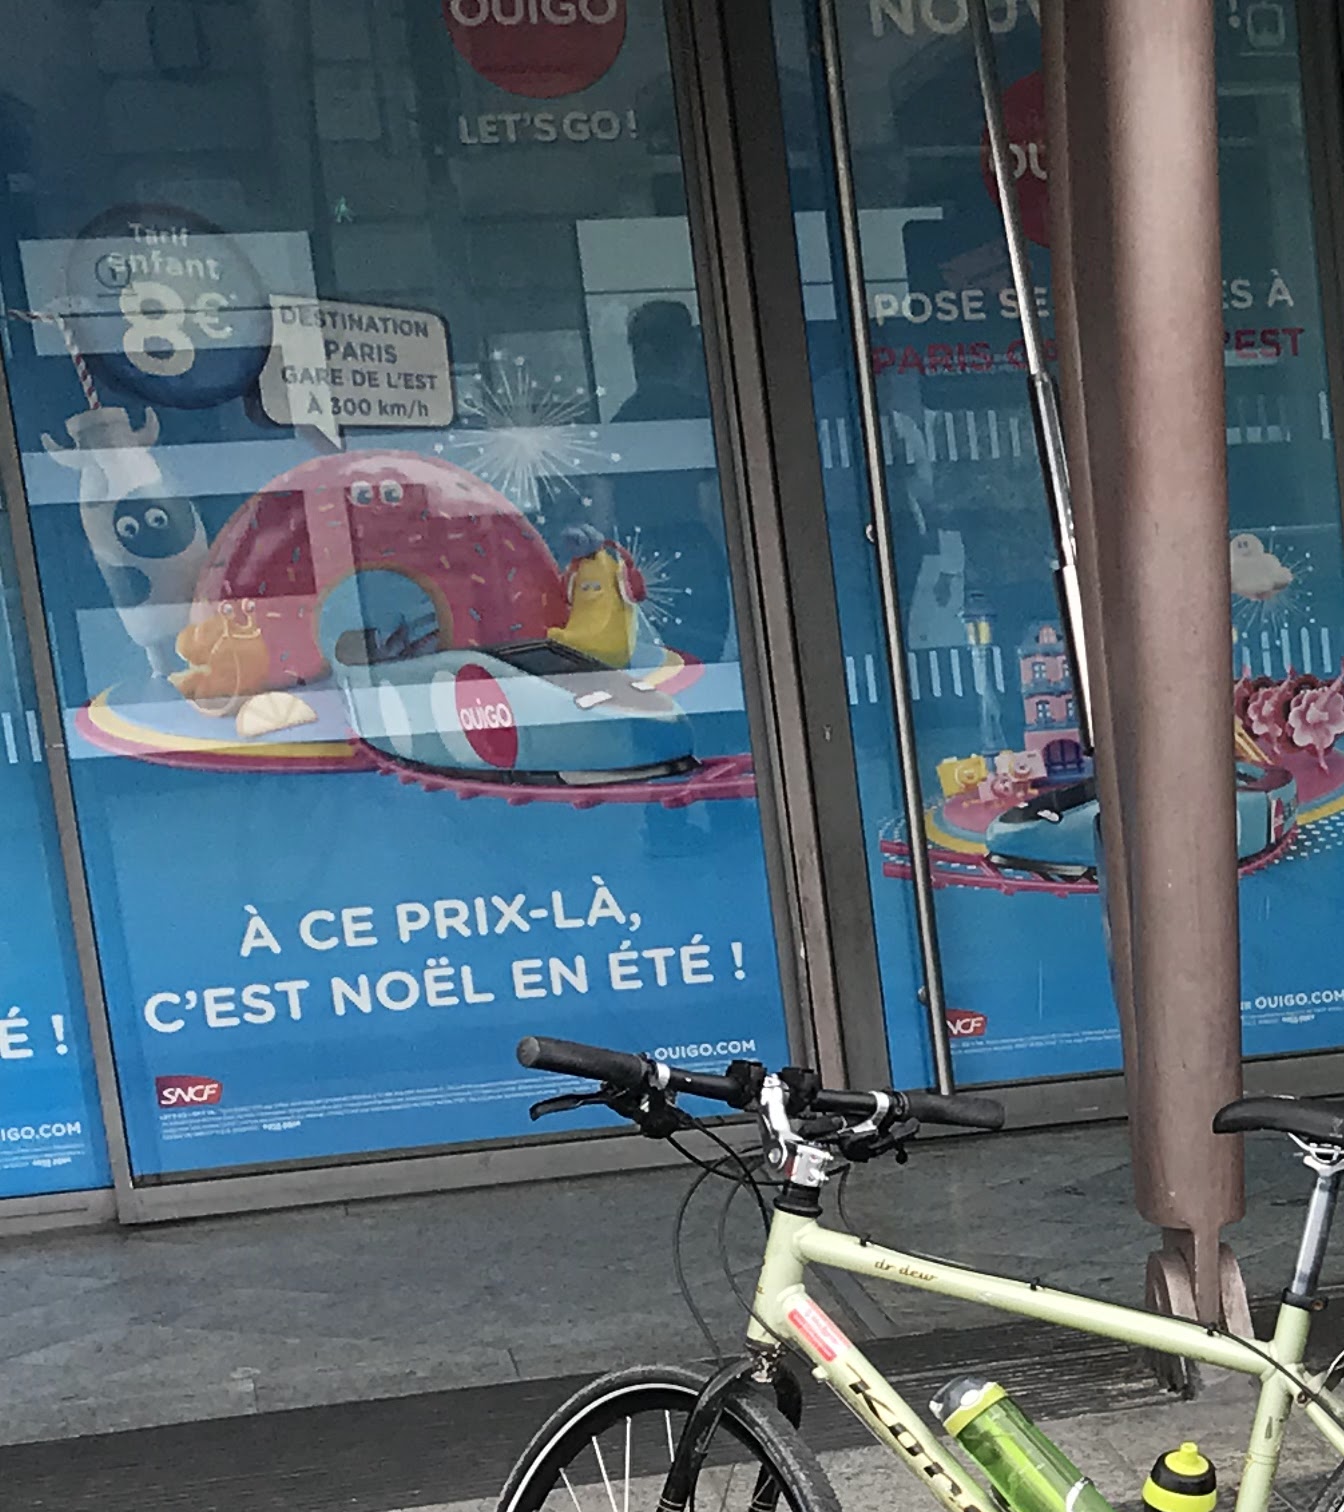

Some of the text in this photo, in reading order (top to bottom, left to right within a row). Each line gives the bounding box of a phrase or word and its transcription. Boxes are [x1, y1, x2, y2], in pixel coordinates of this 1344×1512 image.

[458, 111, 558, 146] LET'S
[562, 110, 622, 142] GO
[127, 221, 189, 247] Tarif
[106, 250, 220, 281] enfant
[874, 288, 987, 327] POSE
[1268, 268, 1295, 308] À
[280, 306, 429, 338] DESTINATION
[324, 339, 398, 364] PARIS
[873, 340, 993, 375] PARIS
[281, 365, 438, 390] GARE DE L'EST
[331, 396, 371, 417] 300
[379, 398, 429, 420] km/h
[460, 697, 513, 730] OUIGO
[240, 875, 643, 958] À CE PRIX-LÀ,
[143, 932, 748, 1034] C'EST NOËL EN ÉTÉ !
[947, 1016, 985, 1036] NCF
[652, 1038, 757, 1063] OUIGO.COM
[160, 1082, 219, 1106] SNCF
